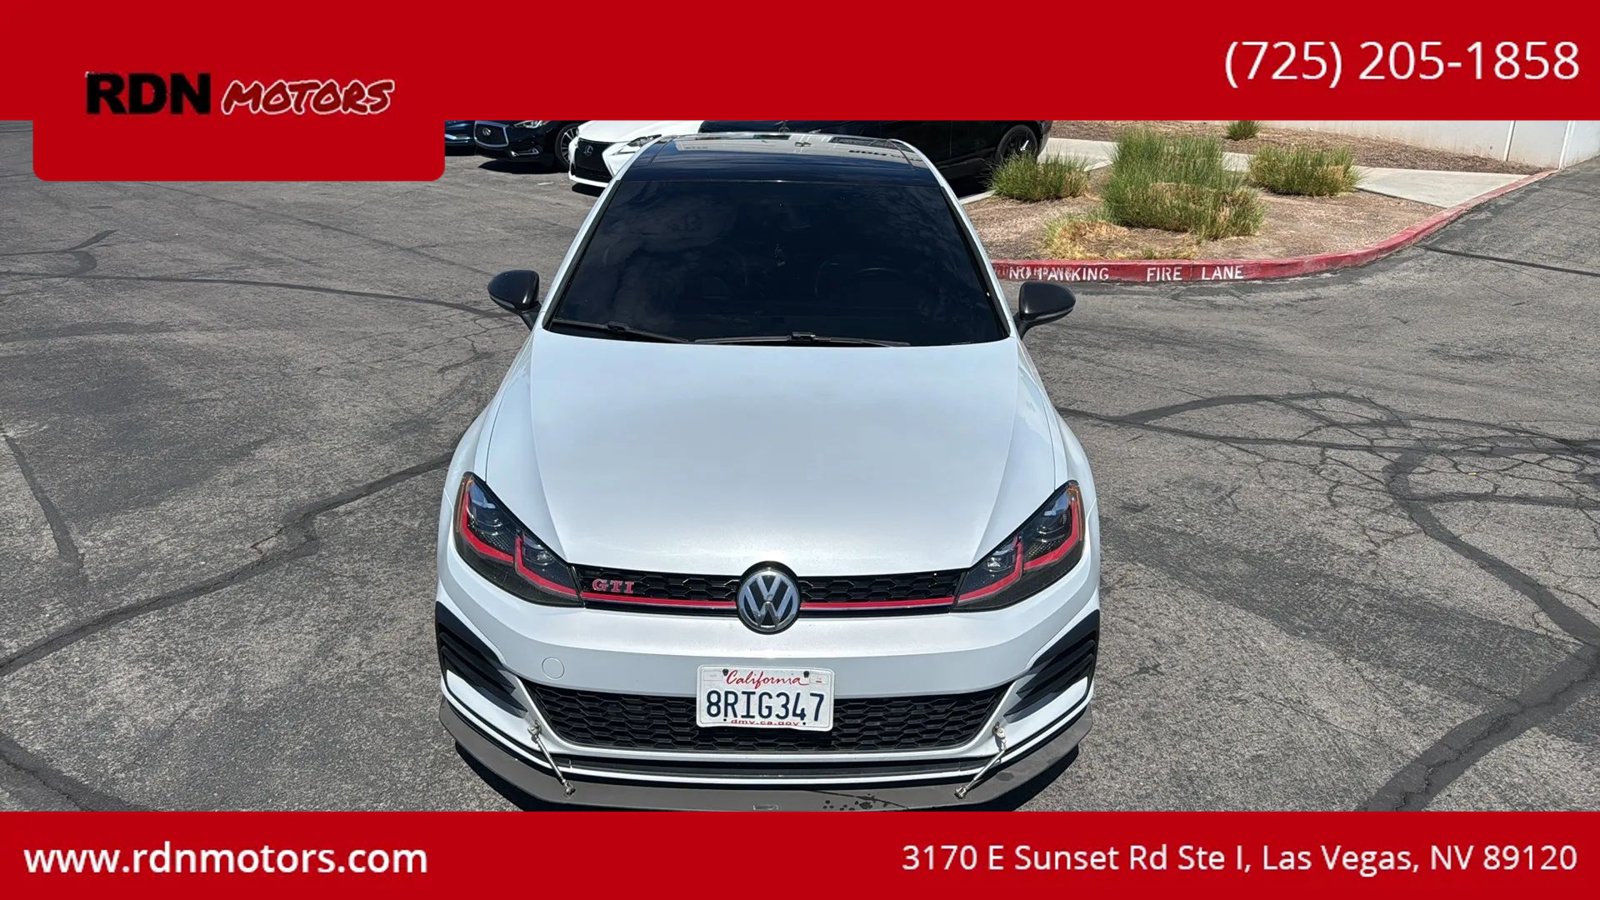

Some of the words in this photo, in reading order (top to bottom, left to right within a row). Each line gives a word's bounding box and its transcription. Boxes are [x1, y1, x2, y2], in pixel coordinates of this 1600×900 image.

[1146, 266, 1183, 282] FIRE
[1201, 265, 1244, 281] LANE
[591, 578, 635, 594] GTI
[726, 669, 809, 690] California
[706, 690, 825, 722] 8RIG347
